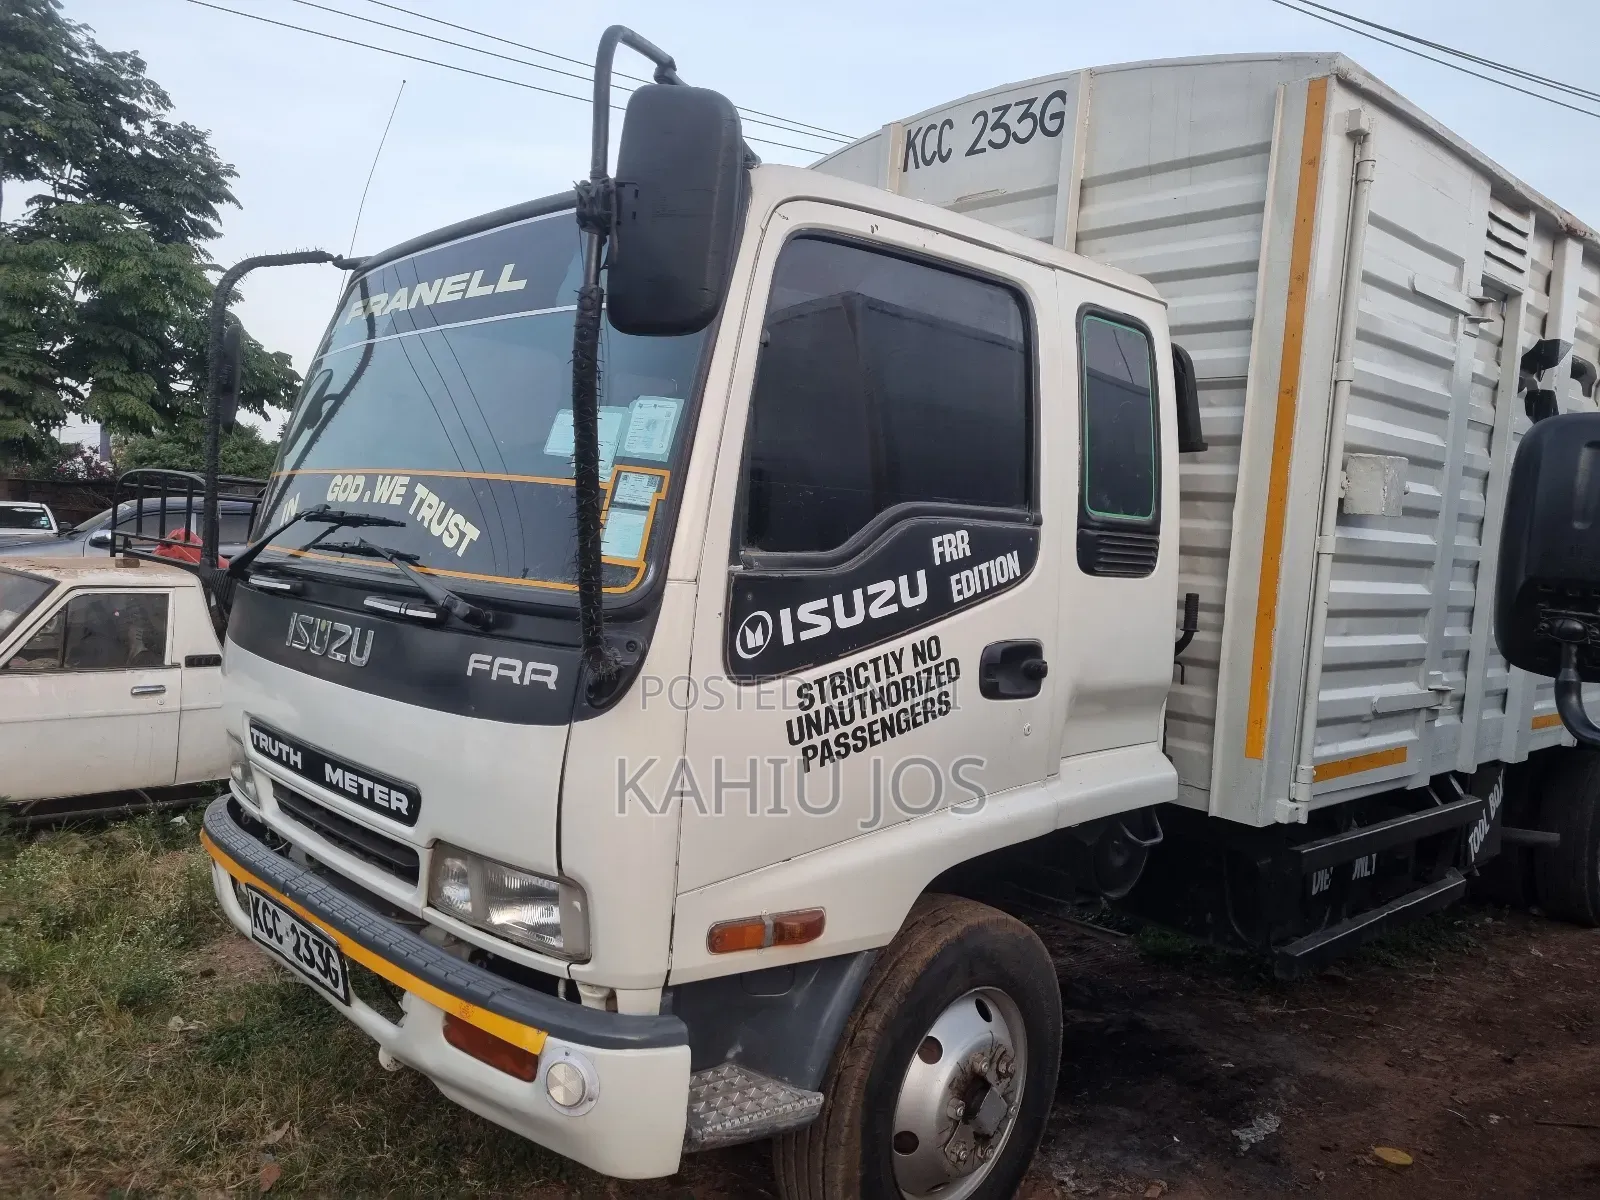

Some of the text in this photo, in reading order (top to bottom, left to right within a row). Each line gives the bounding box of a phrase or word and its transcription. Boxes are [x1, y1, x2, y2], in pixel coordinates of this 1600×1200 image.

[903, 90, 1067, 172] KCC 233G
[345, 264, 527, 325] FRANELL
[408, 483, 480, 557] TRUST
[932, 529, 971, 566] FRR
[779, 569, 928, 646] ISUZU
[950, 550, 1021, 603] EDITION
[285, 612, 375, 667] ISUZU
[466, 653, 559, 690] FRR
[797, 635, 942, 712] STRICTLY NO
[786, 657, 961, 747] UNAUTHORIZED
[801, 690, 951, 773] PASSENGERS
[250, 727, 409, 816] TRUTH METER
[1468, 808, 1490, 863] TOOL
[249, 891, 340, 989] KCC 233G
